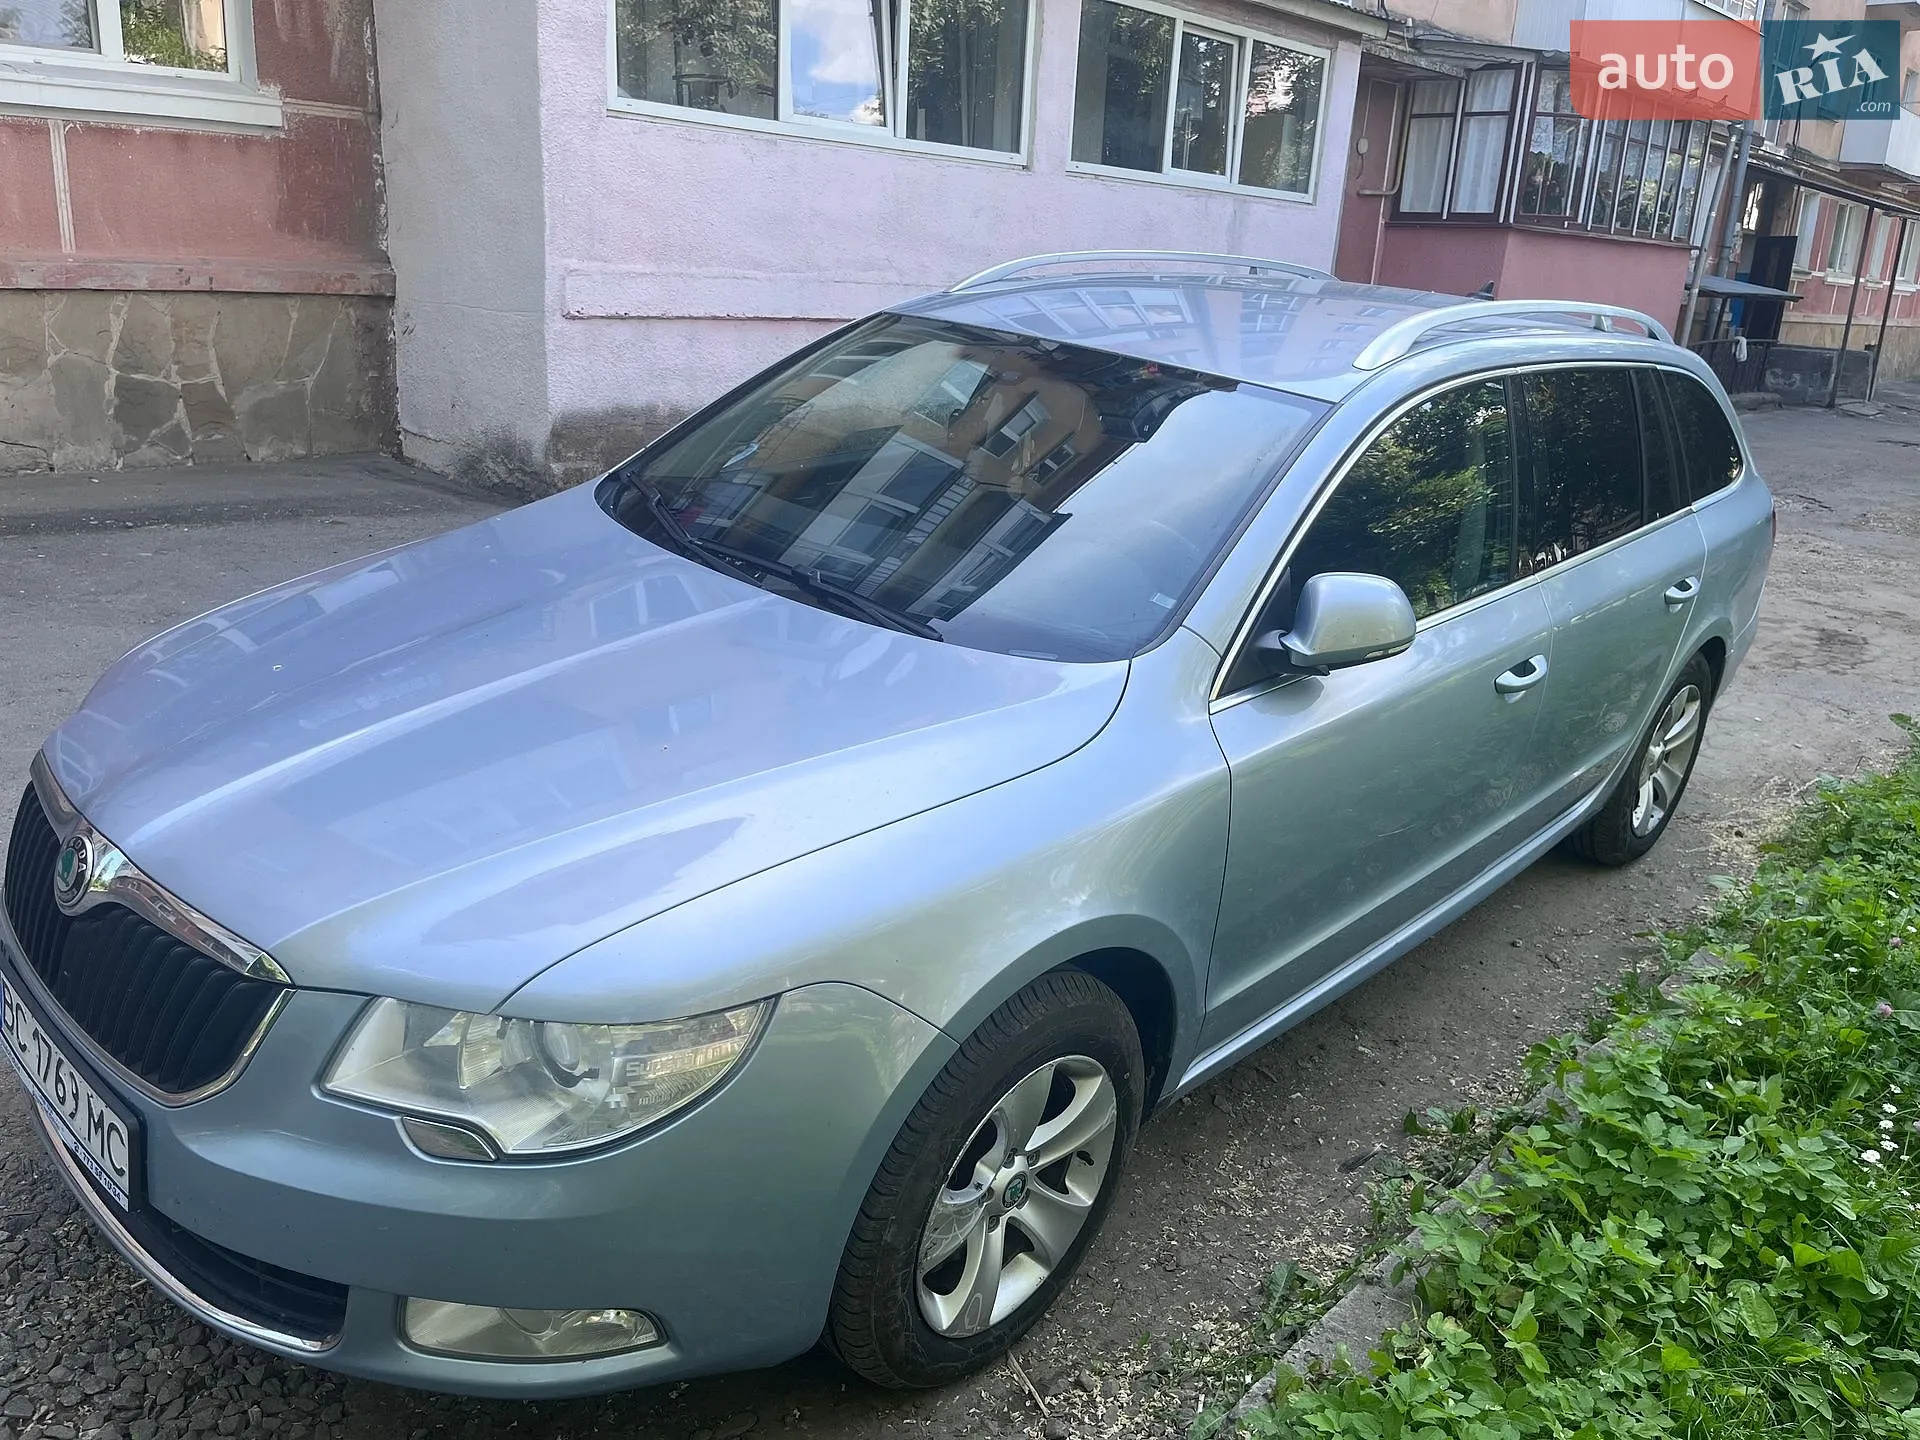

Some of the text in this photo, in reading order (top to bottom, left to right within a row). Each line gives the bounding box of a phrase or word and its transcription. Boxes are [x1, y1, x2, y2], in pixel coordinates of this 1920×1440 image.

[3, 979, 28, 1053] BC
[32, 1027, 79, 1119] 1769
[87, 1091, 126, 1177] MC
